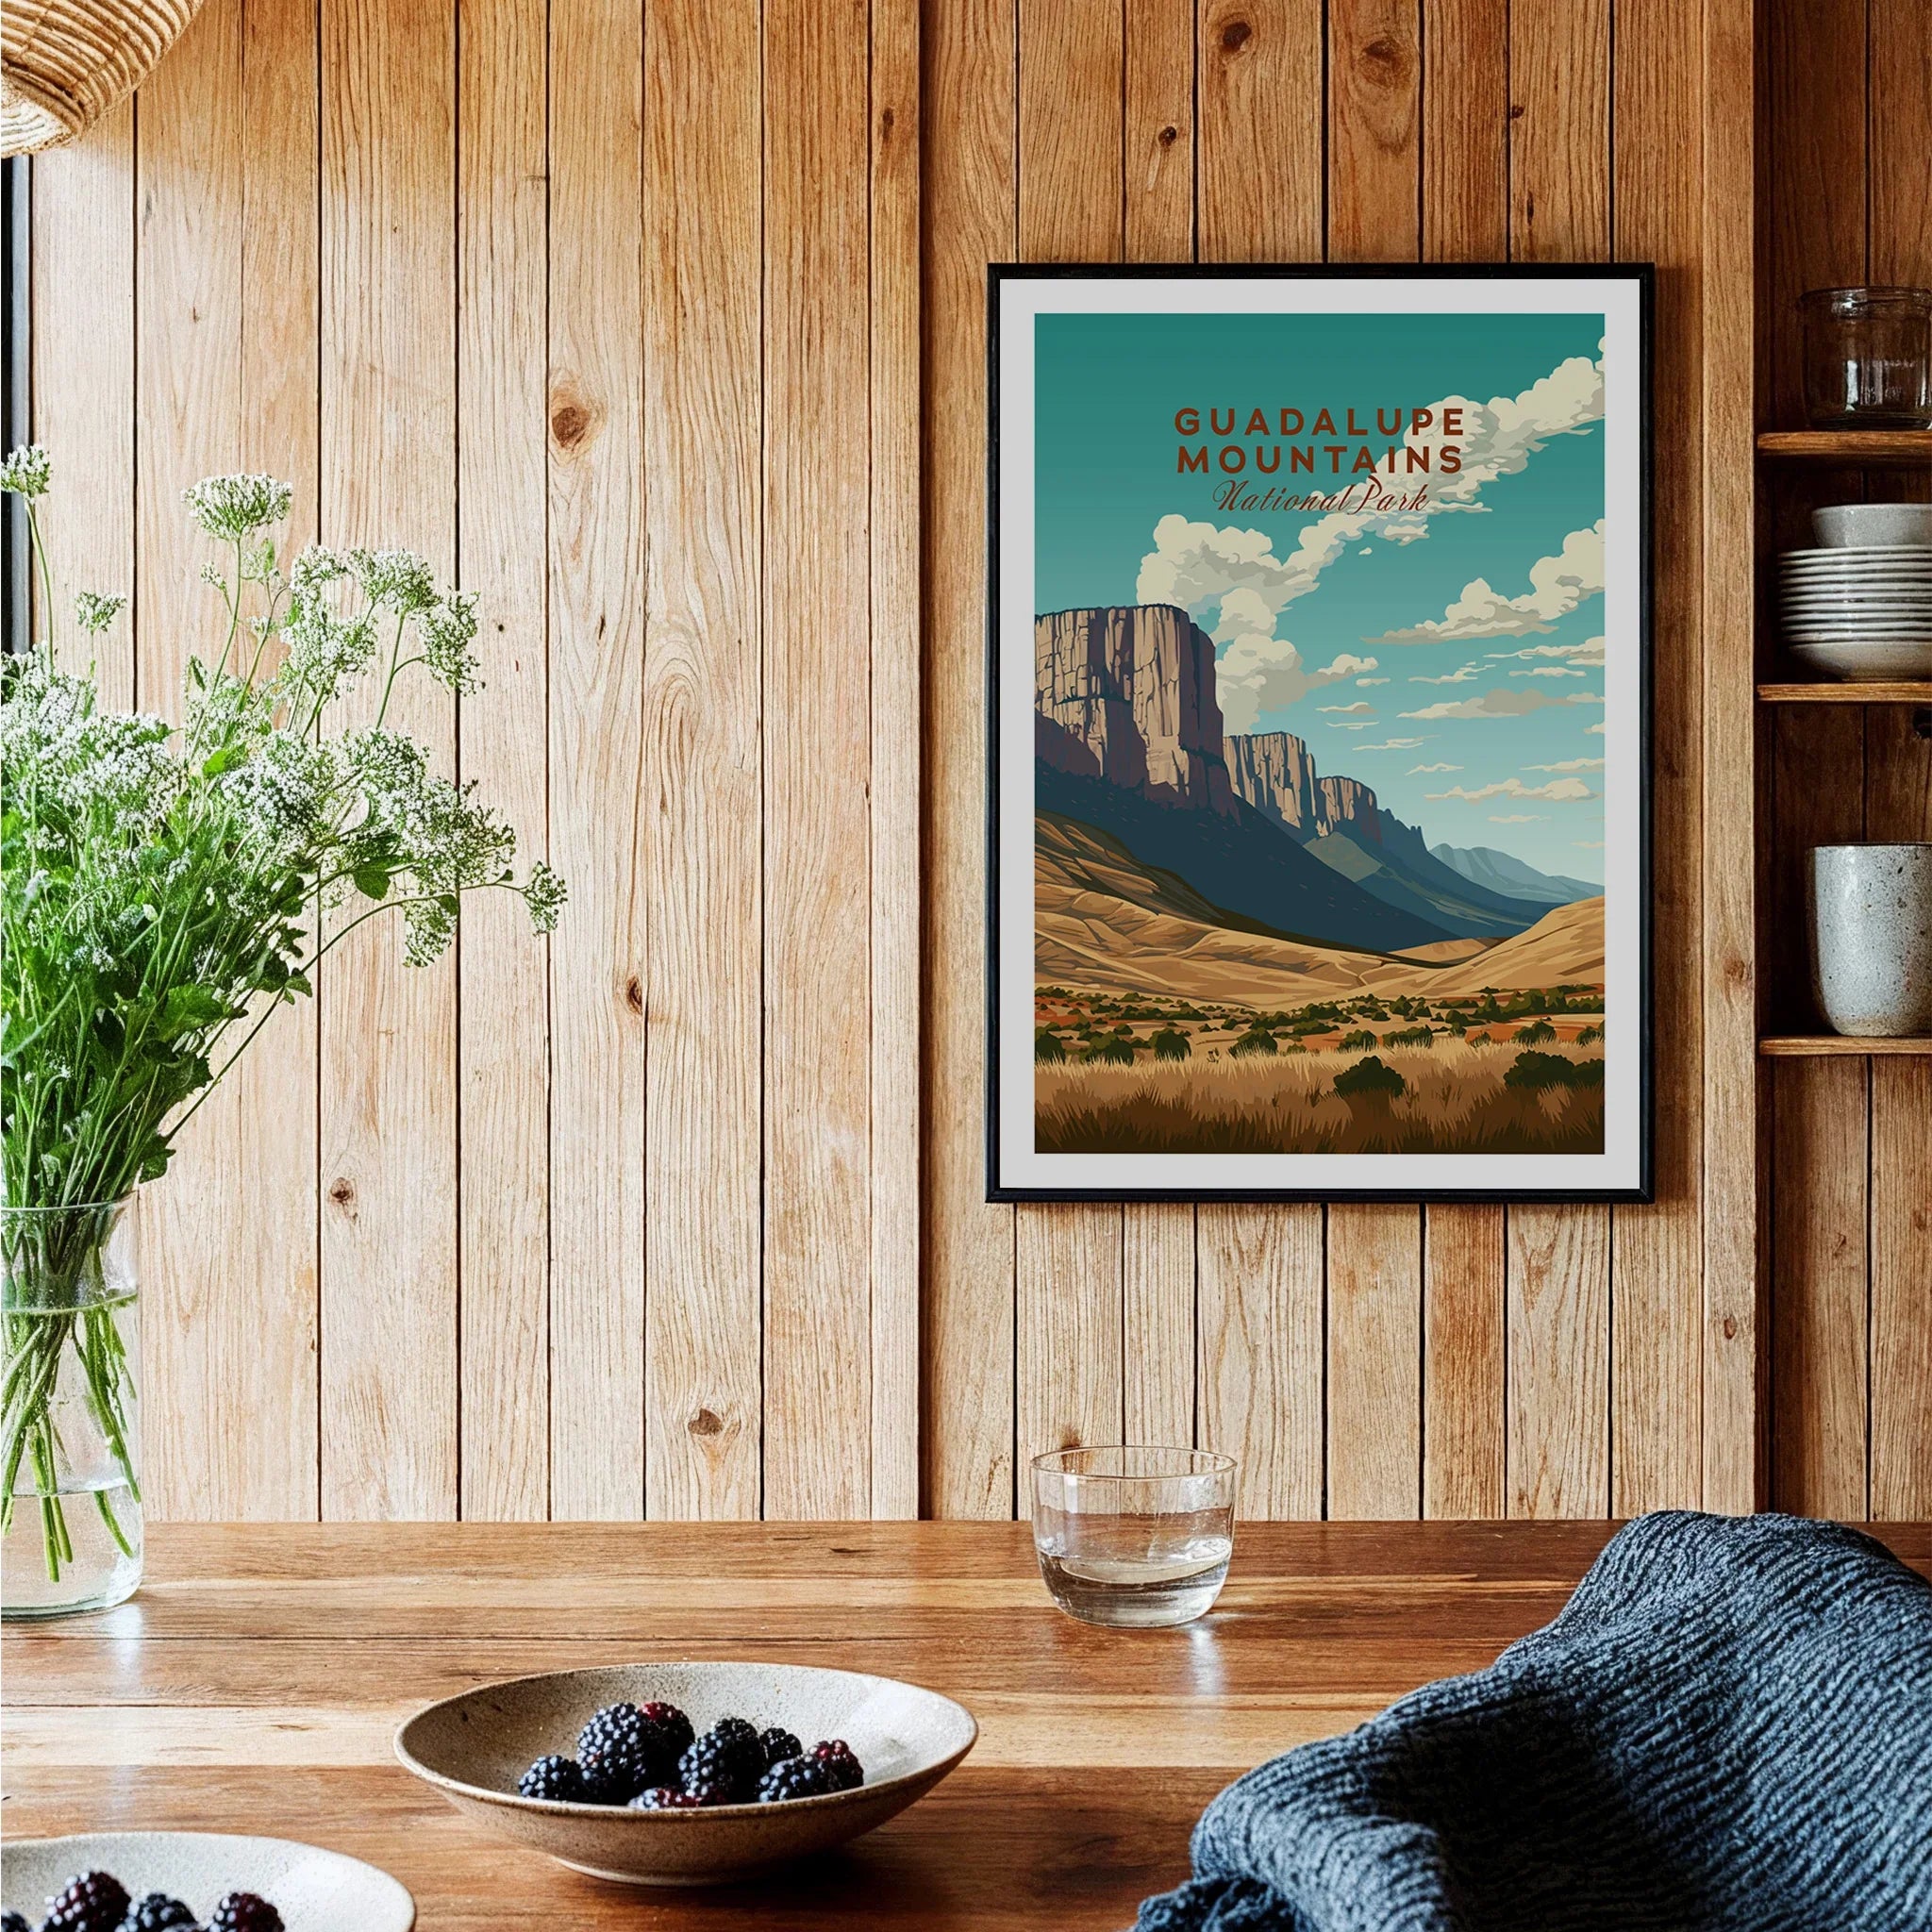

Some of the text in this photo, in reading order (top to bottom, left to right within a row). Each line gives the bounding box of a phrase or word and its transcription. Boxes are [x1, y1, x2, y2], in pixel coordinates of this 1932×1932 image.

[1174, 408, 1464, 436] GUADALUPE
[1176, 445, 1462, 474] MOUNTAINS
[1212, 475, 1429, 515] National Park
